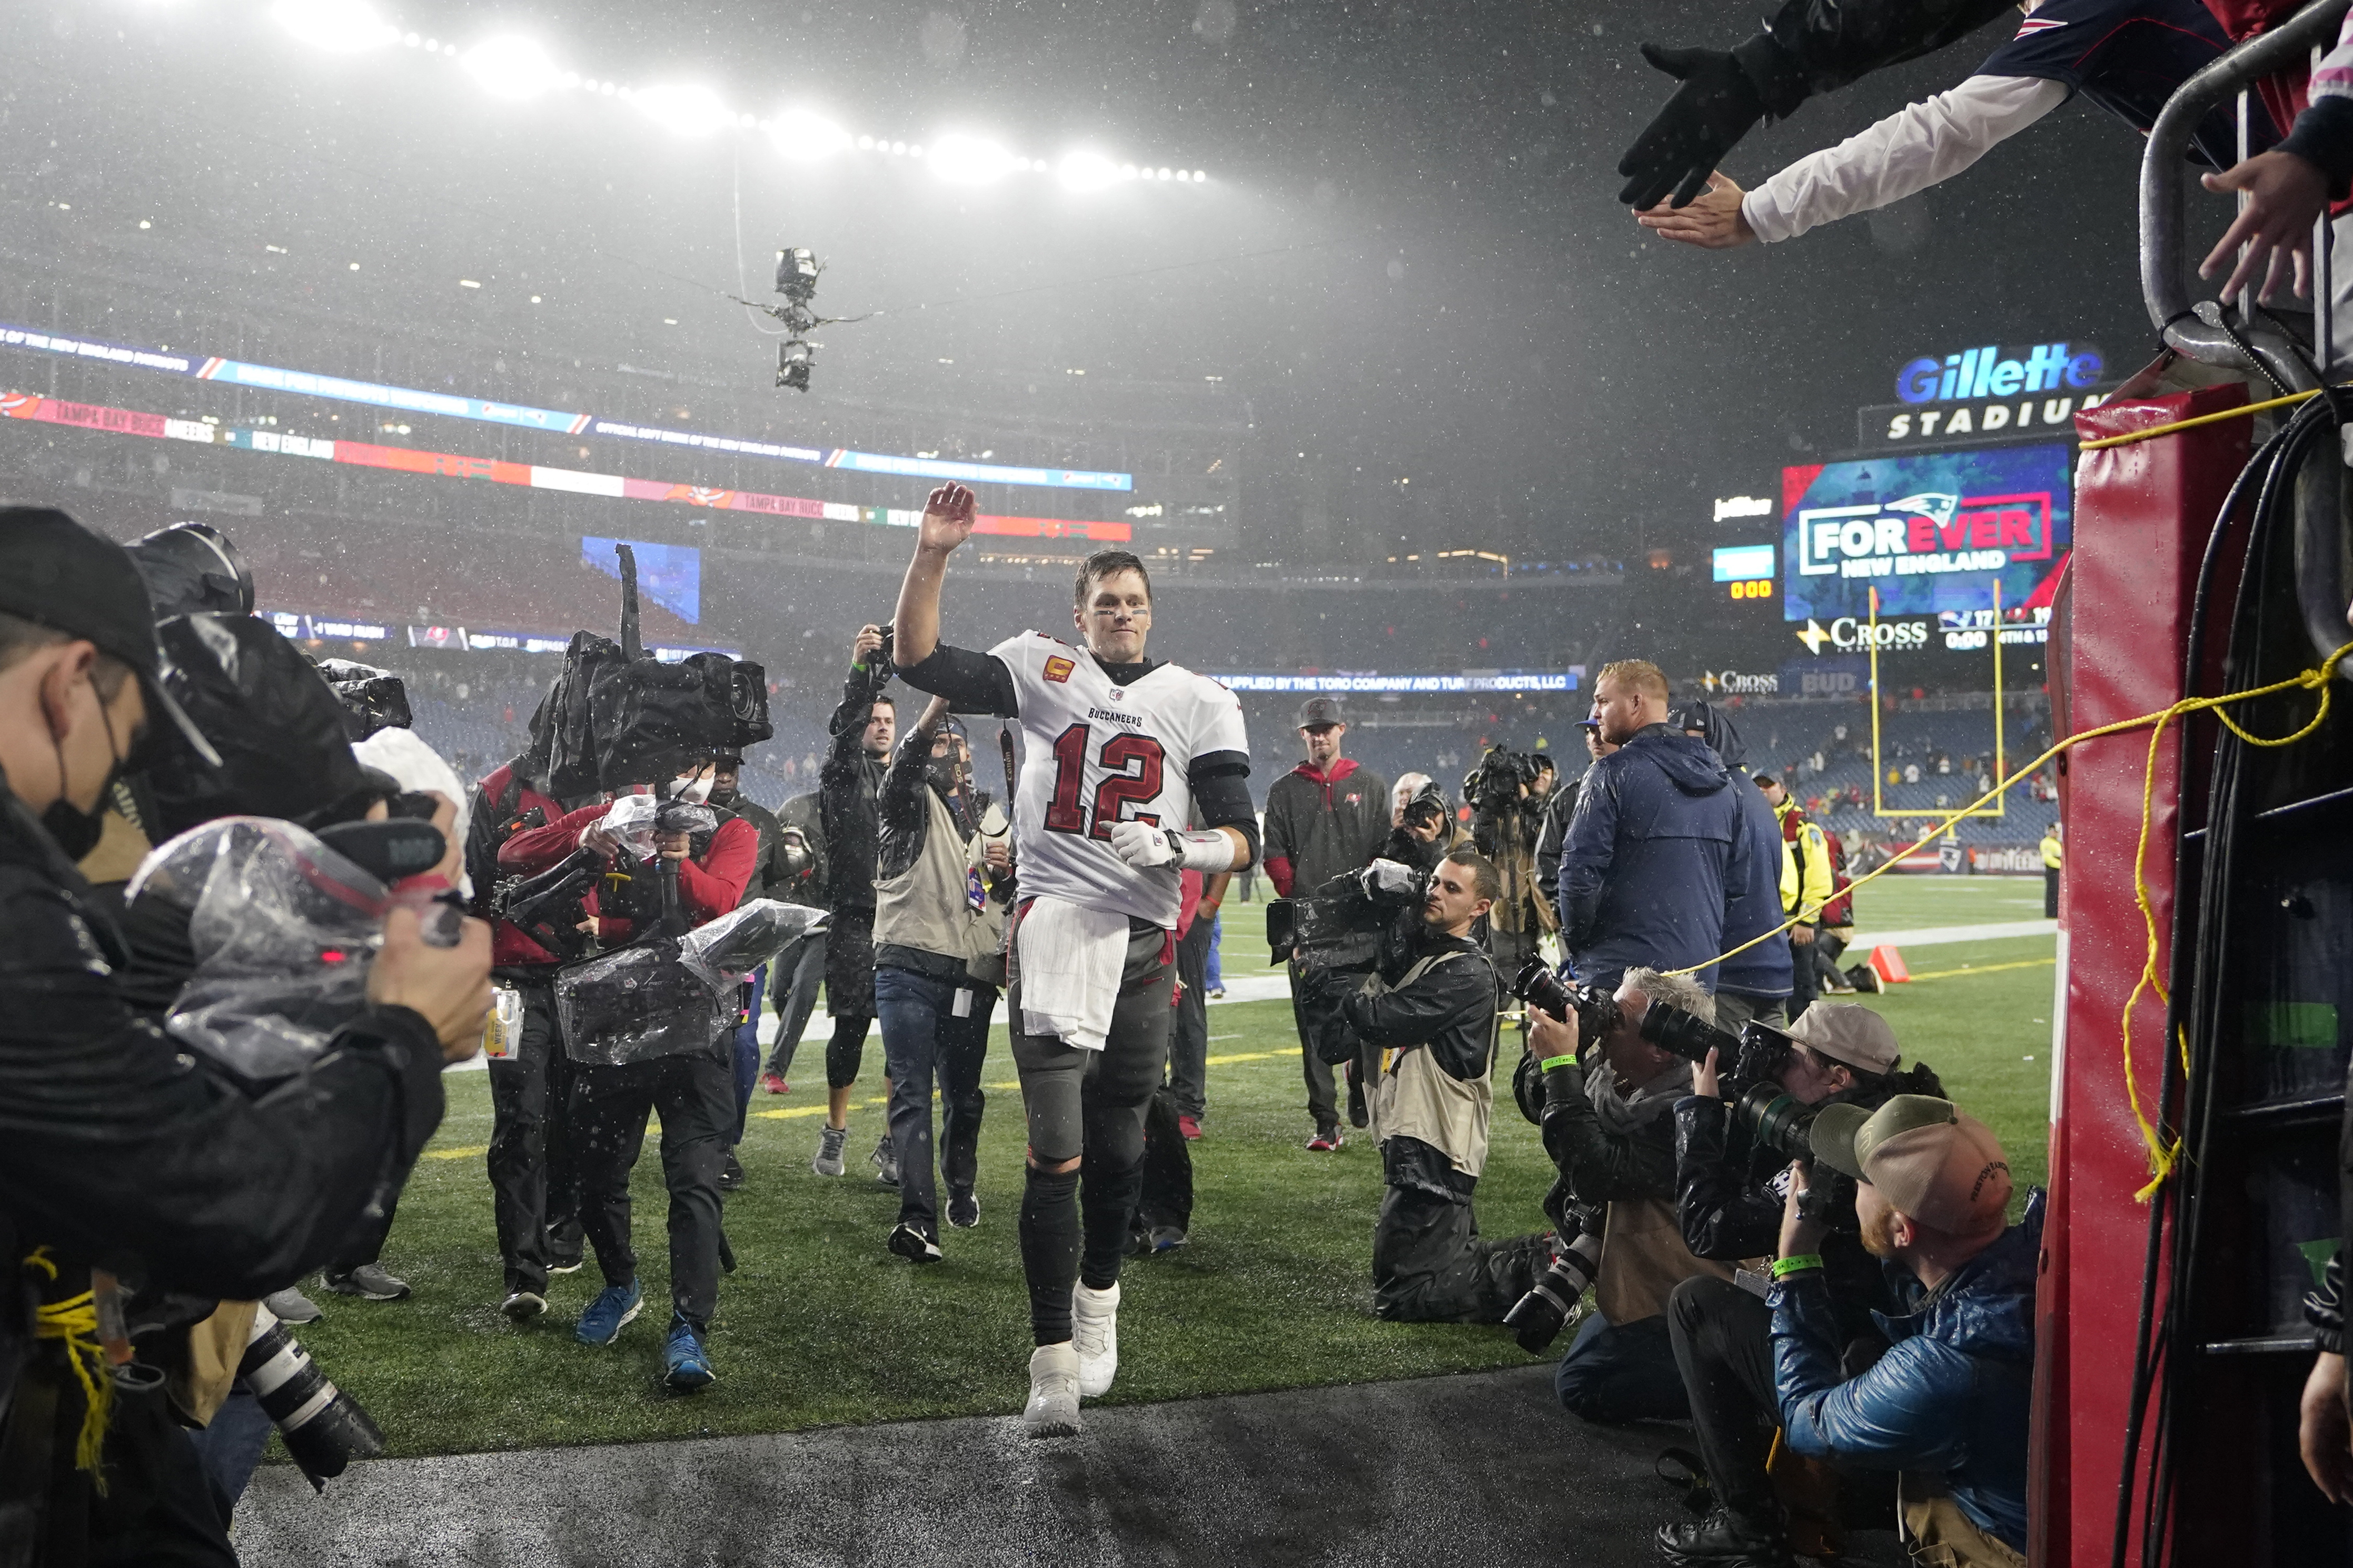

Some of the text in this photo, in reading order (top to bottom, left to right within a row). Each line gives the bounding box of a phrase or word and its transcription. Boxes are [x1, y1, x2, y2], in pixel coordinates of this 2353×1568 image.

[1898, 343, 2103, 404] Gillette
[744, 493, 776, 511] TAMPA
[779, 498, 796, 513] BAY
[1814, 509, 2033, 560] FOREVER
[1841, 550, 2005, 578] NEW ENGLAND
[1731, 580, 1772, 599] 0:00
[1974, 610, 1994, 627] 17
[1945, 631, 1987, 649] 0:00
[1275, 677, 1293, 690] BY
[1293, 677, 1317, 690] THE
[1317, 677, 1352, 691] TORO
[1352, 677, 1413, 691] COMPANY
[1413, 677, 1441, 690] AND
[1541, 676, 1566, 690] LLC
[1801, 673, 1856, 692] BUD
[954, 763, 964, 783] EOS
[1043, 723, 1166, 842] 12
